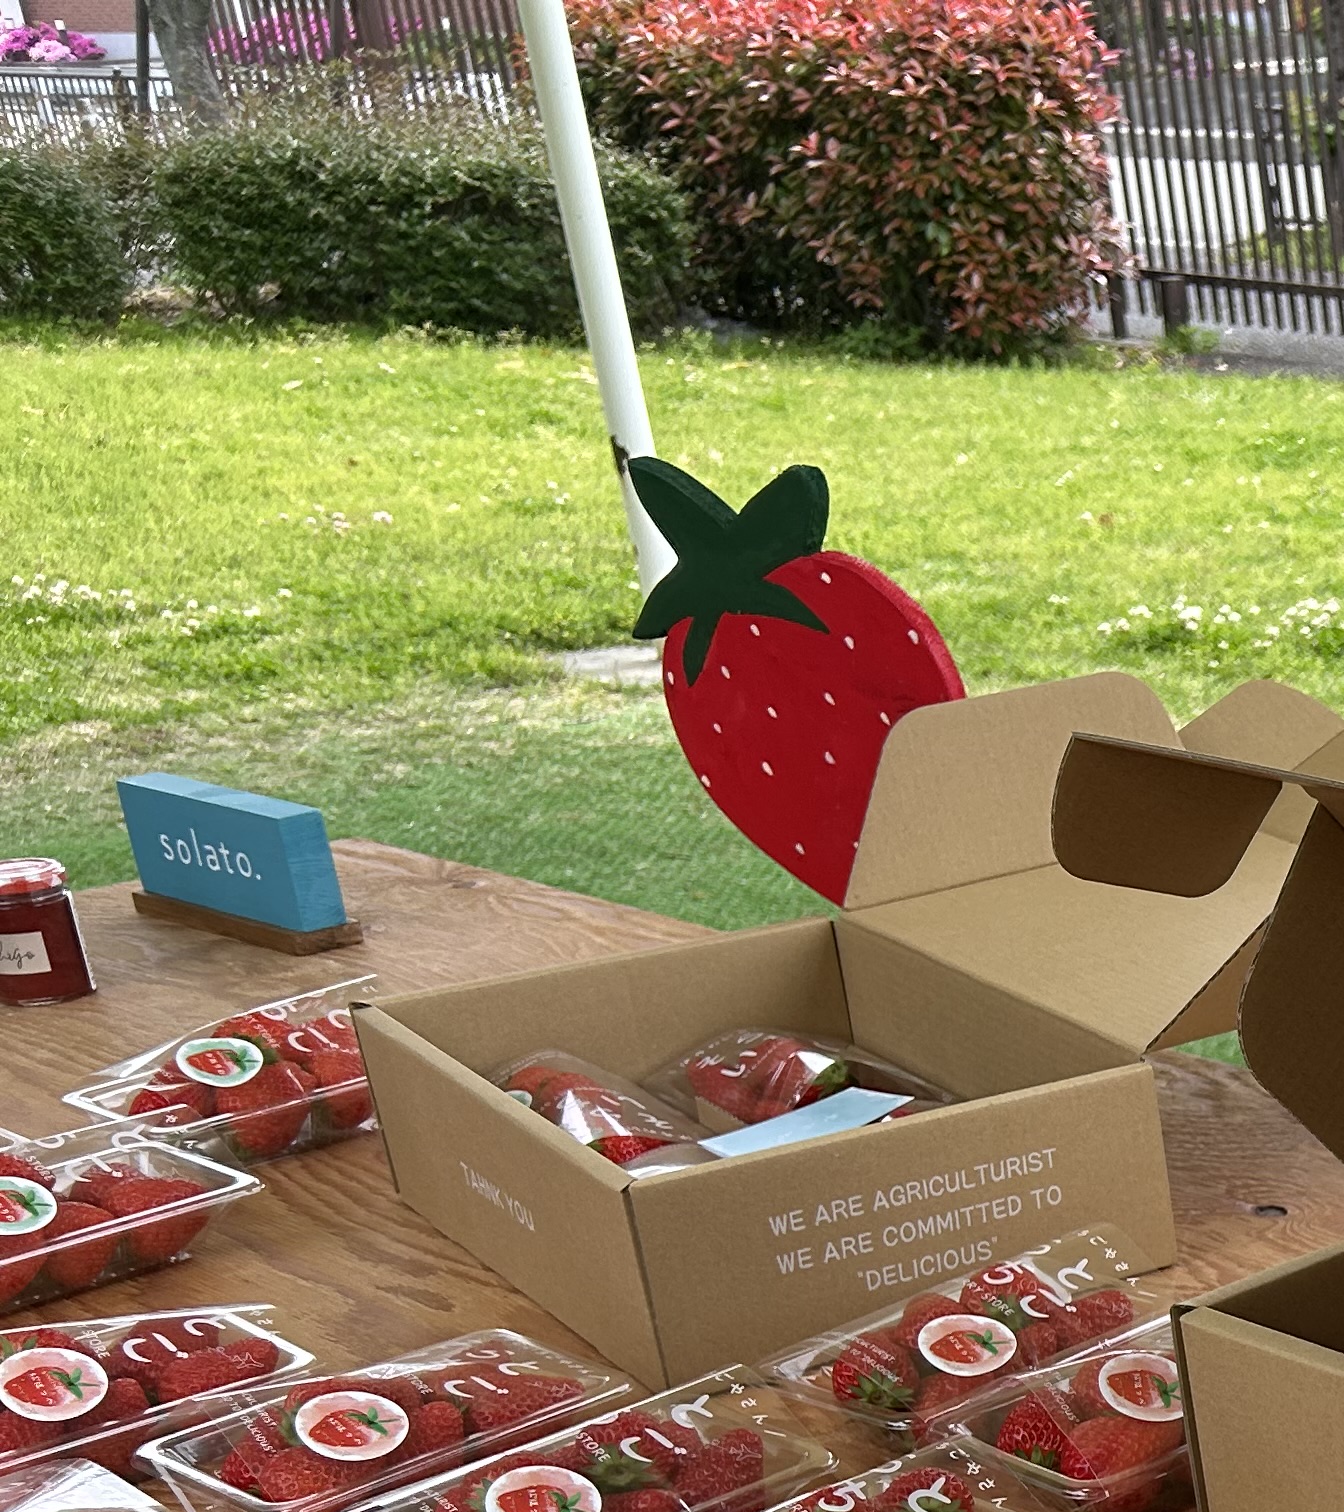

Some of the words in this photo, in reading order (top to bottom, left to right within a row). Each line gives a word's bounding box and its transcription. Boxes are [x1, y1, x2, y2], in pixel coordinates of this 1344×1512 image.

[159, 828, 262, 881] solato.
[459, 1160, 505, 1209] TAHNK
[505, 1192, 535, 1232] YOU
[768, 1212, 805, 1237] WE
[814, 1199, 866, 1228] ARE
[872, 1148, 1057, 1209] AGRICULTURIST
[776, 1248, 813, 1275] WE
[823, 1236, 875, 1266] ARE
[882, 1193, 1024, 1247] COMMITTED
[1031, 1185, 1063, 1208] TO
[857, 1236, 998, 1292] "DELICIOUS"
[576, 1431, 612, 1463] STORE
